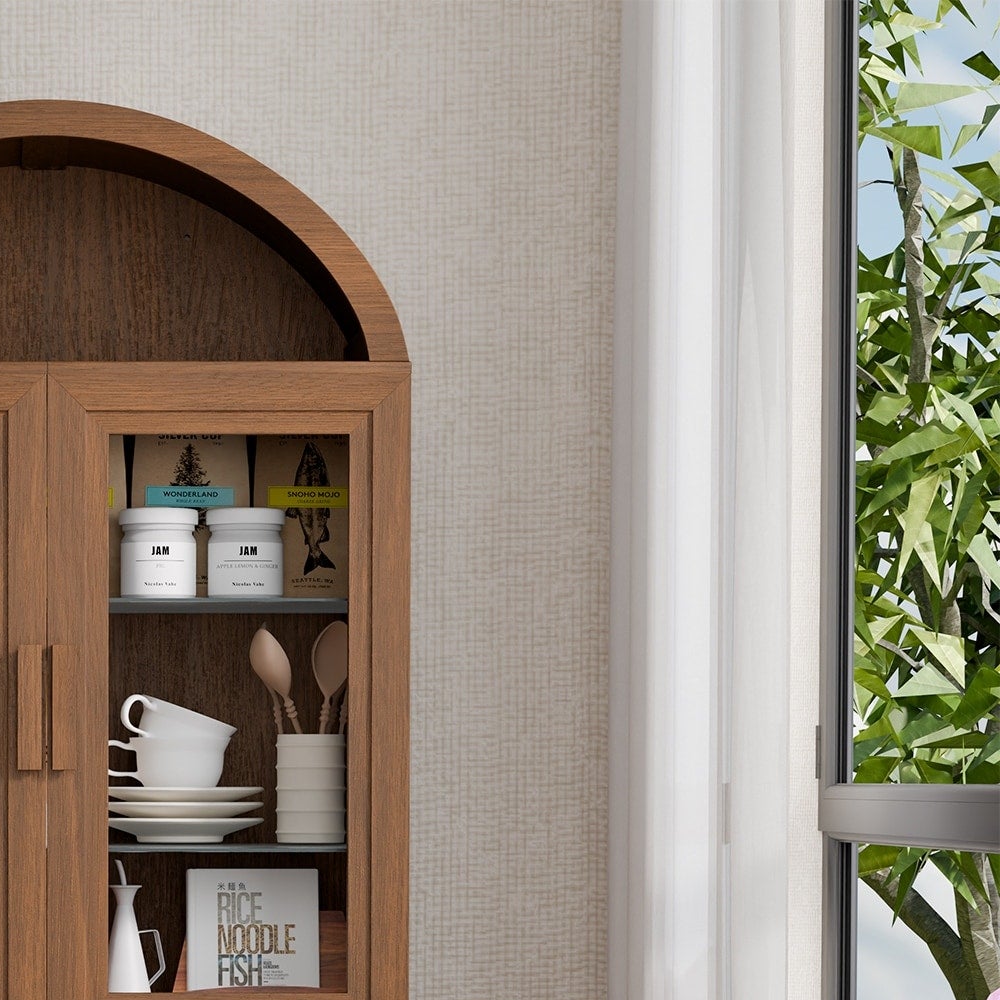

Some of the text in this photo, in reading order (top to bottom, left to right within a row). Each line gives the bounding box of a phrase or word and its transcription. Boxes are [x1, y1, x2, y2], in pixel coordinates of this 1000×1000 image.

[151, 545, 170, 556] JAM
[239, 545, 258, 556] JAM
[217, 892, 262, 924] RICE
[217, 924, 296, 955] NOODLE
[218, 954, 263, 987] FISH
